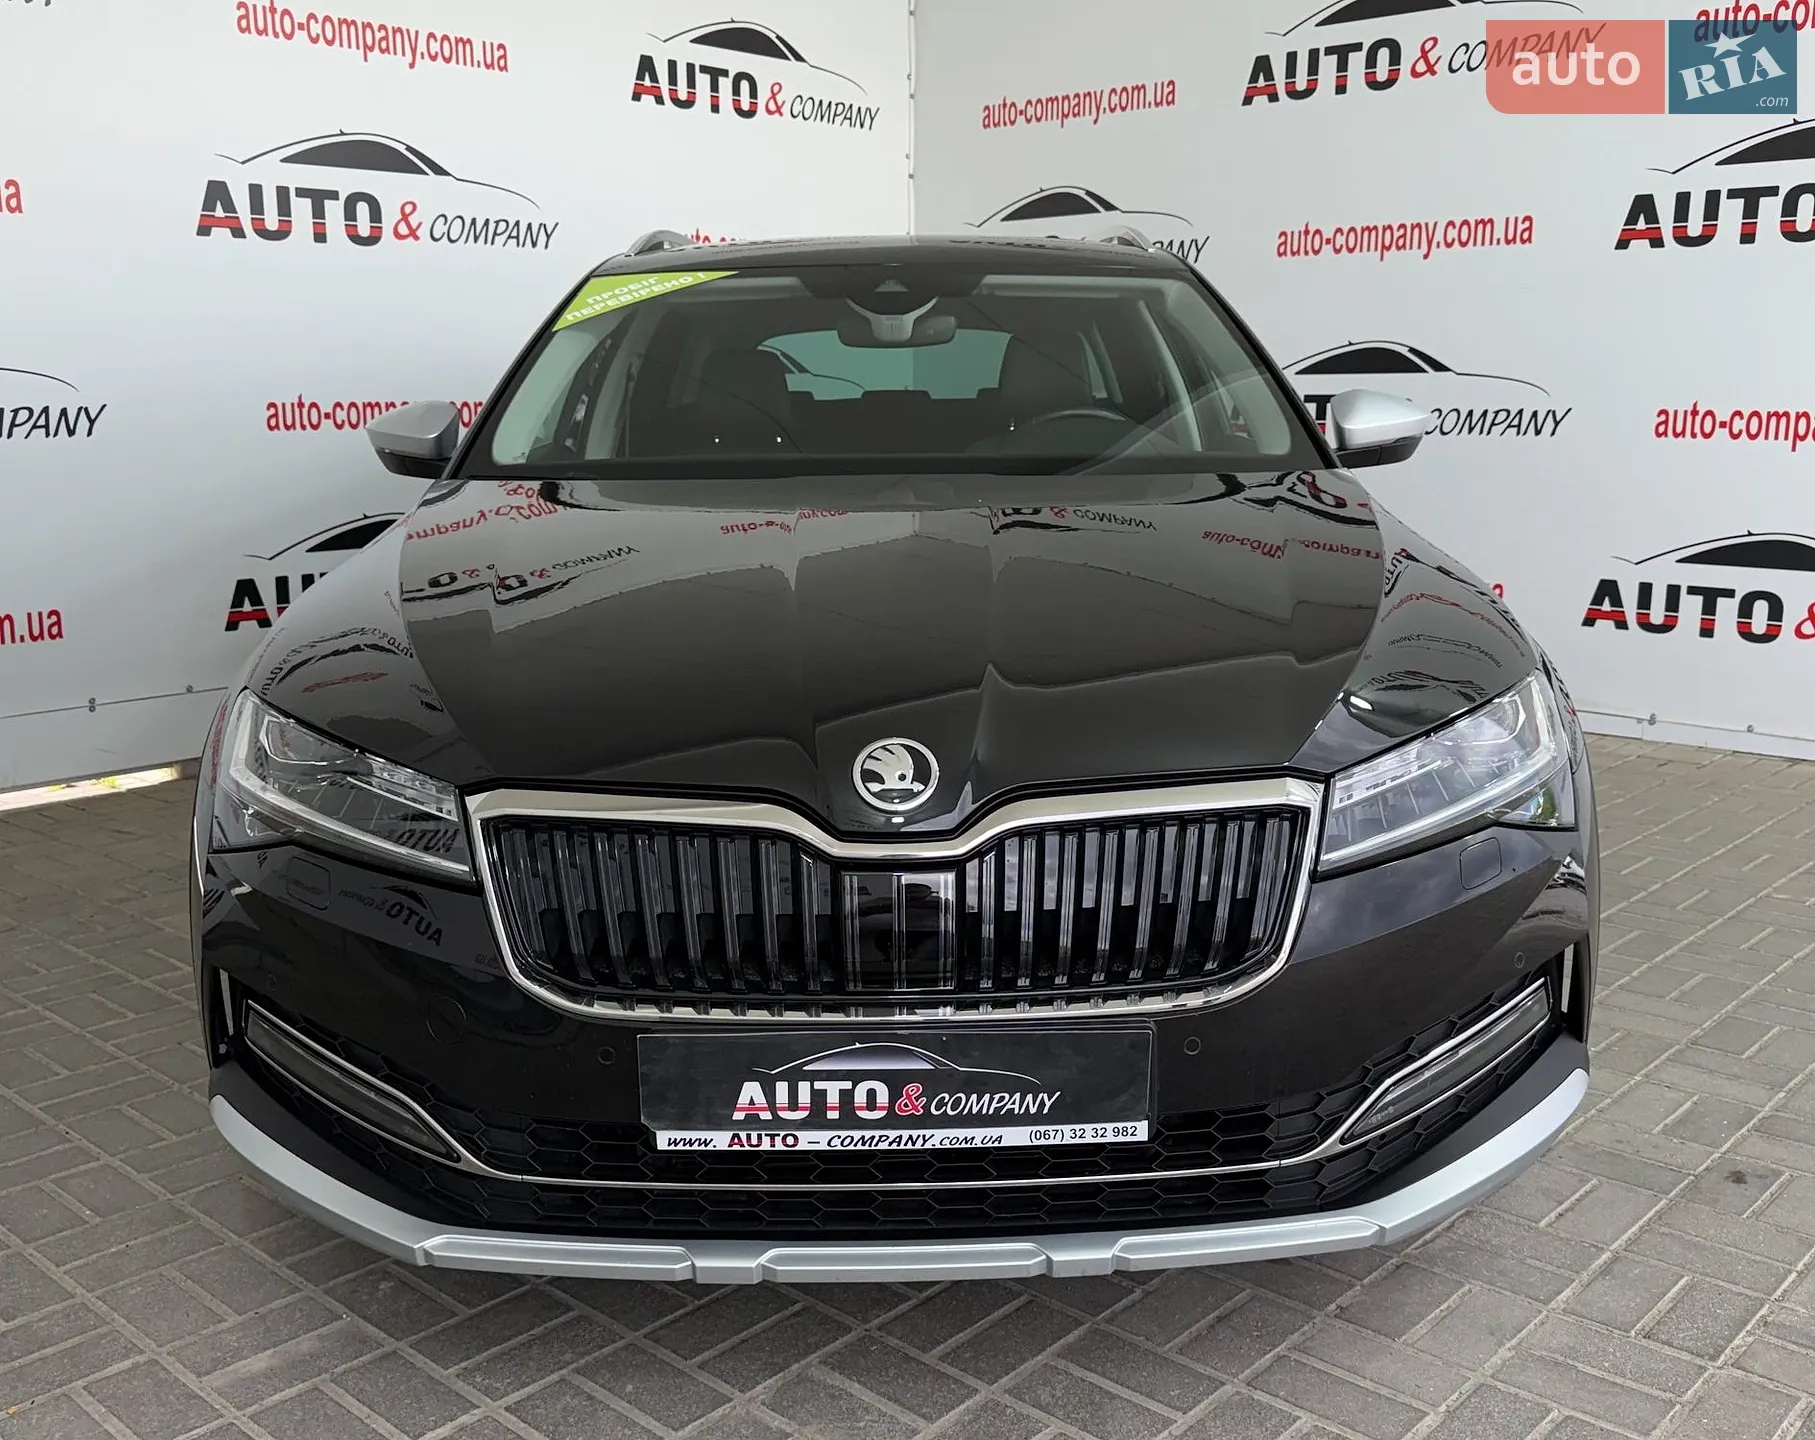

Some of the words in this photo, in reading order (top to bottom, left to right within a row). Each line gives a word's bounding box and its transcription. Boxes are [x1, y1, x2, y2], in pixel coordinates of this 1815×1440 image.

[236, 0, 509, 73] auto-company.com.ua
[631, 53, 758, 119] AUTO
[764, 81, 785, 117] &
[790, 94, 880, 131] COMPANY
[1241, 37, 1402, 107] AUTO
[1410, 36, 1442, 79] &
[982, 78, 1177, 129] auto-company.com.ua
[196, 179, 384, 247] AUTO
[392, 201, 424, 242] &
[429, 213, 559, 250] COMPANY
[1276, 214, 1535, 261] auto-company.com.ua
[1614, 182, 1815, 251] AUTO
[1424, 407, 1573, 437] COMPANY
[1581, 578, 1784, 644] AUTO
[732, 1080, 890, 1121] AUTO
[895, 1083, 926, 1116] &
[930, 1091, 1062, 1116] COMPANY
[728, 1132, 800, 1149] AUTO
[1028, 1127, 1066, 1144] (067)
[1069, 1127, 1087, 1140] 32
[1091, 1126, 1109, 1139] 32
[1111, 1125, 1139, 1138] 982
